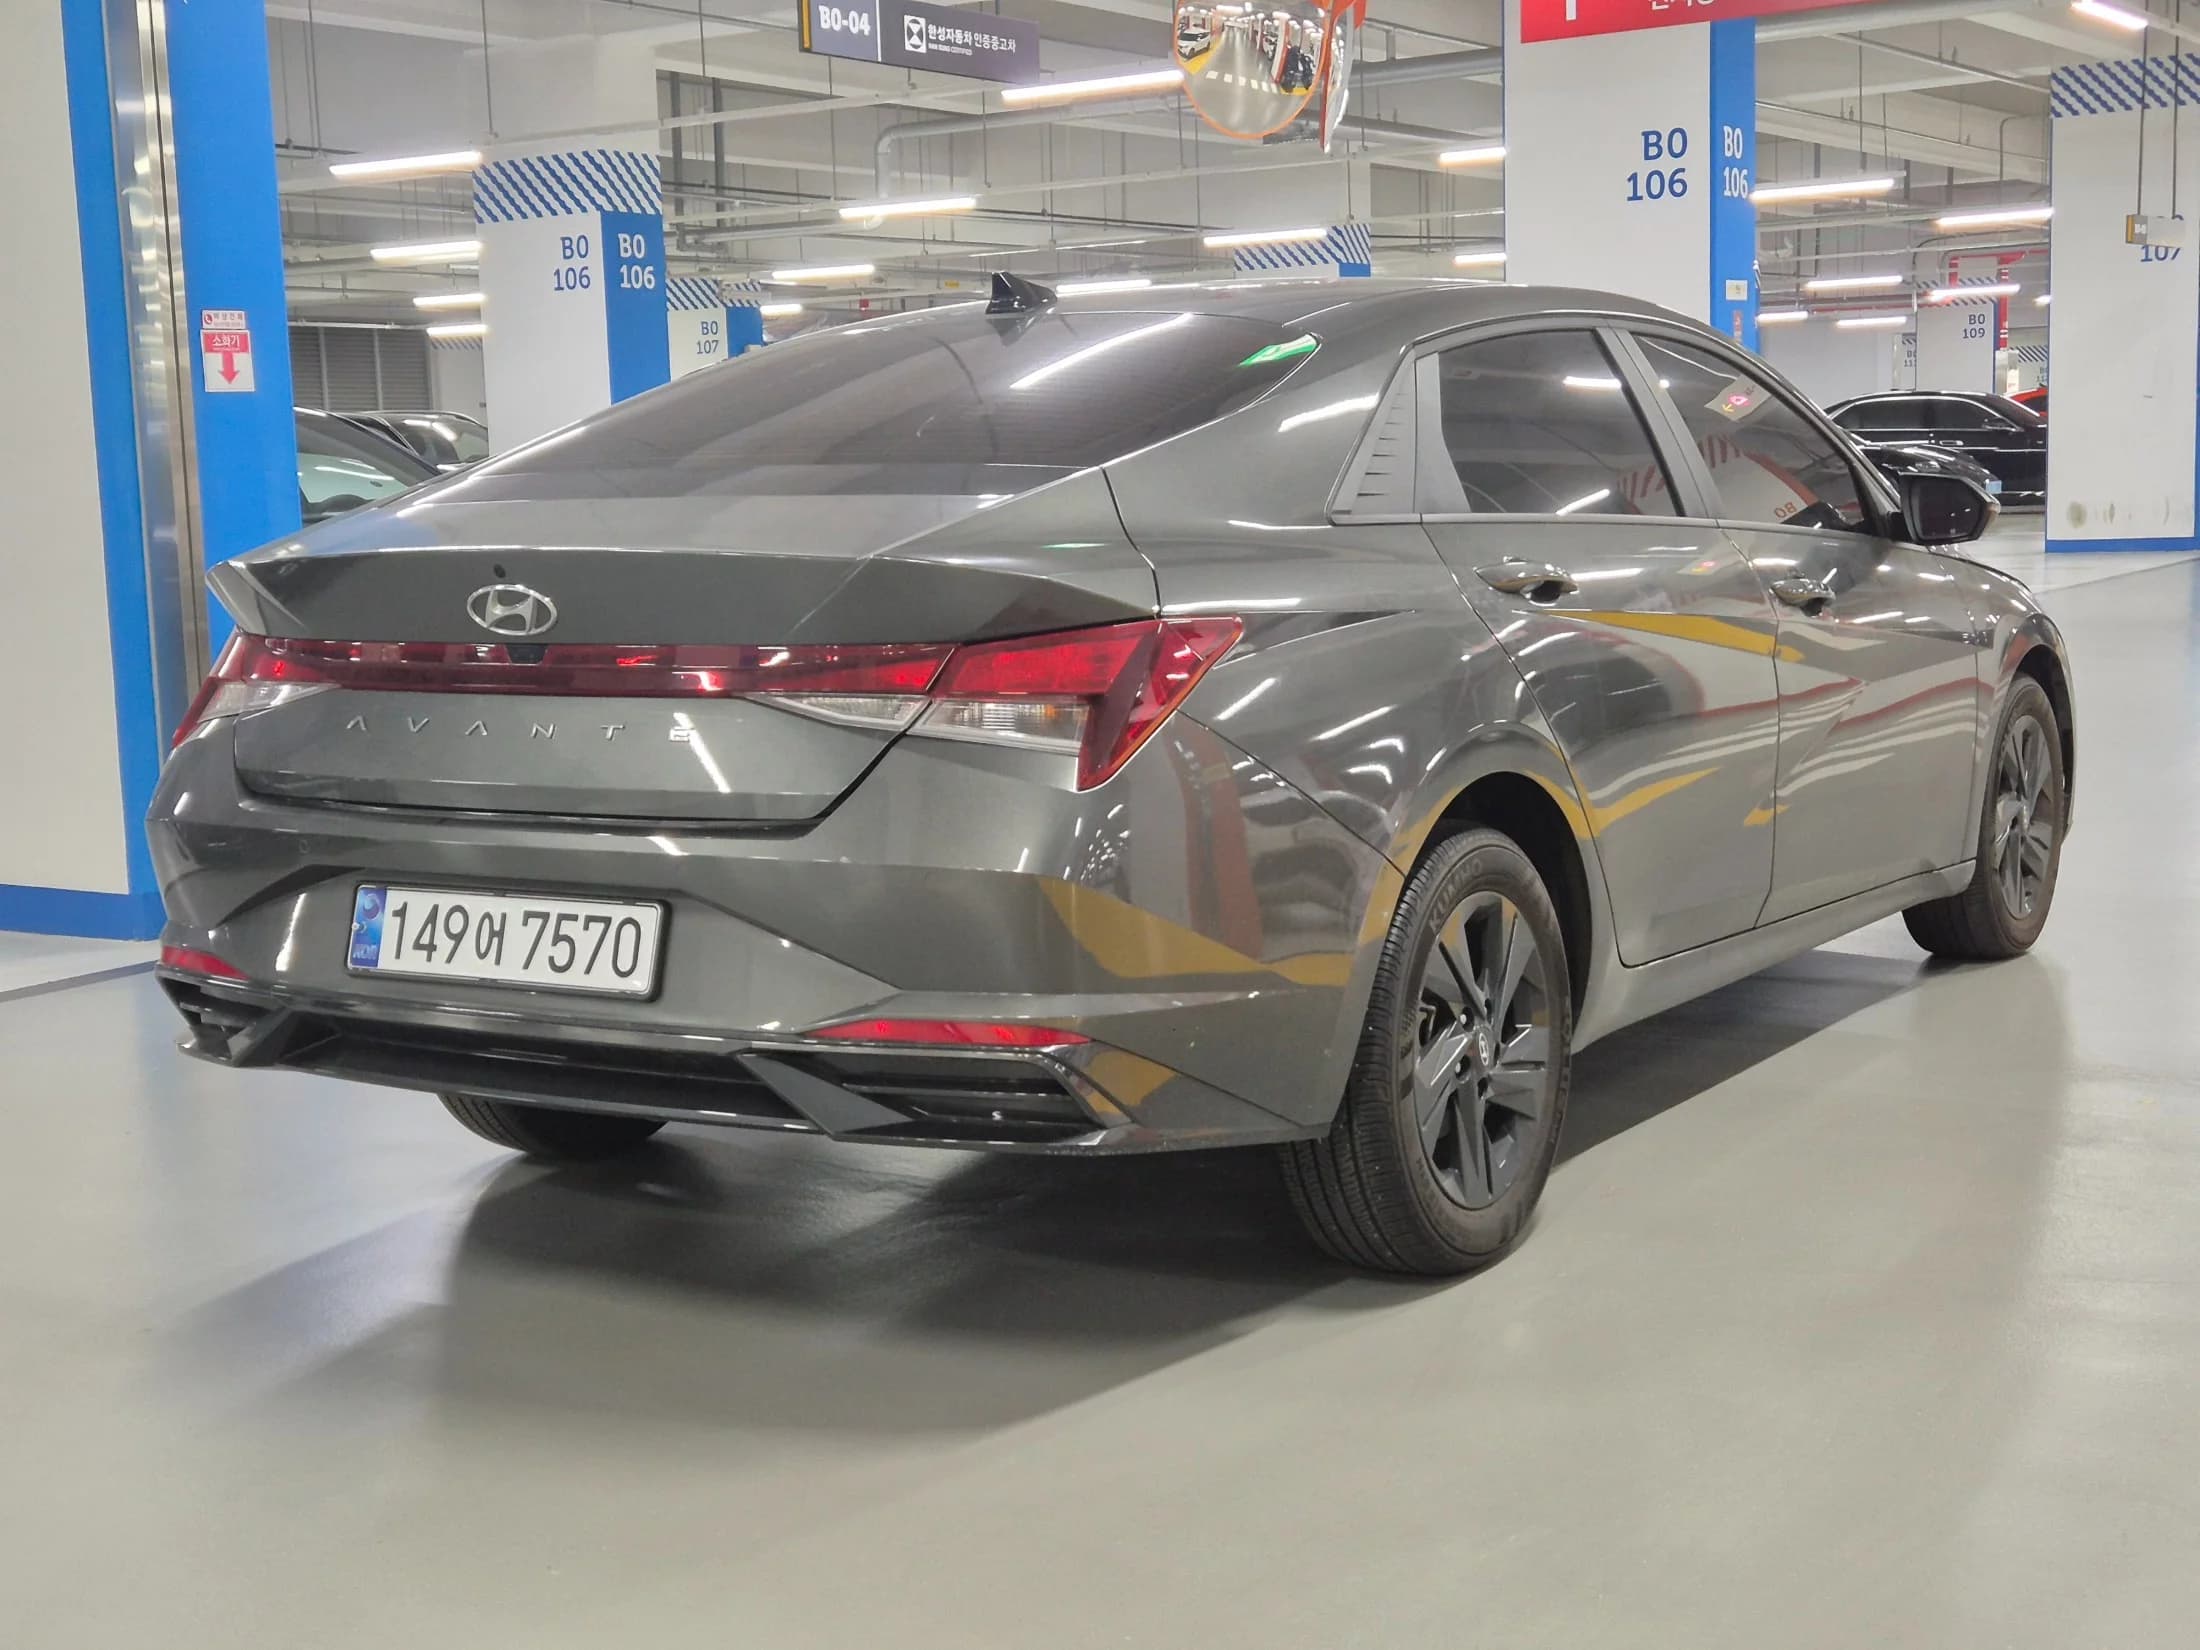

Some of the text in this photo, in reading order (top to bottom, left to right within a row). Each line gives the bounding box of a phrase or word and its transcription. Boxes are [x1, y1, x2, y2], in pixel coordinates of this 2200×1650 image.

[928, 24, 973, 46] 한성자동차
[973, 32, 1017, 53] 인증중고차
[1626, 168, 1688, 201] 106
[1723, 166, 1749, 198] 106
[553, 266, 591, 291] 106
[619, 265, 656, 289] 106
[212, 334, 241, 348] 소화기
[1962, 327, 1986, 339] 109
[696, 340, 719, 355] 107
[346, 714, 692, 743] AVANTE
[391, 900, 642, 979] 149어 7570
